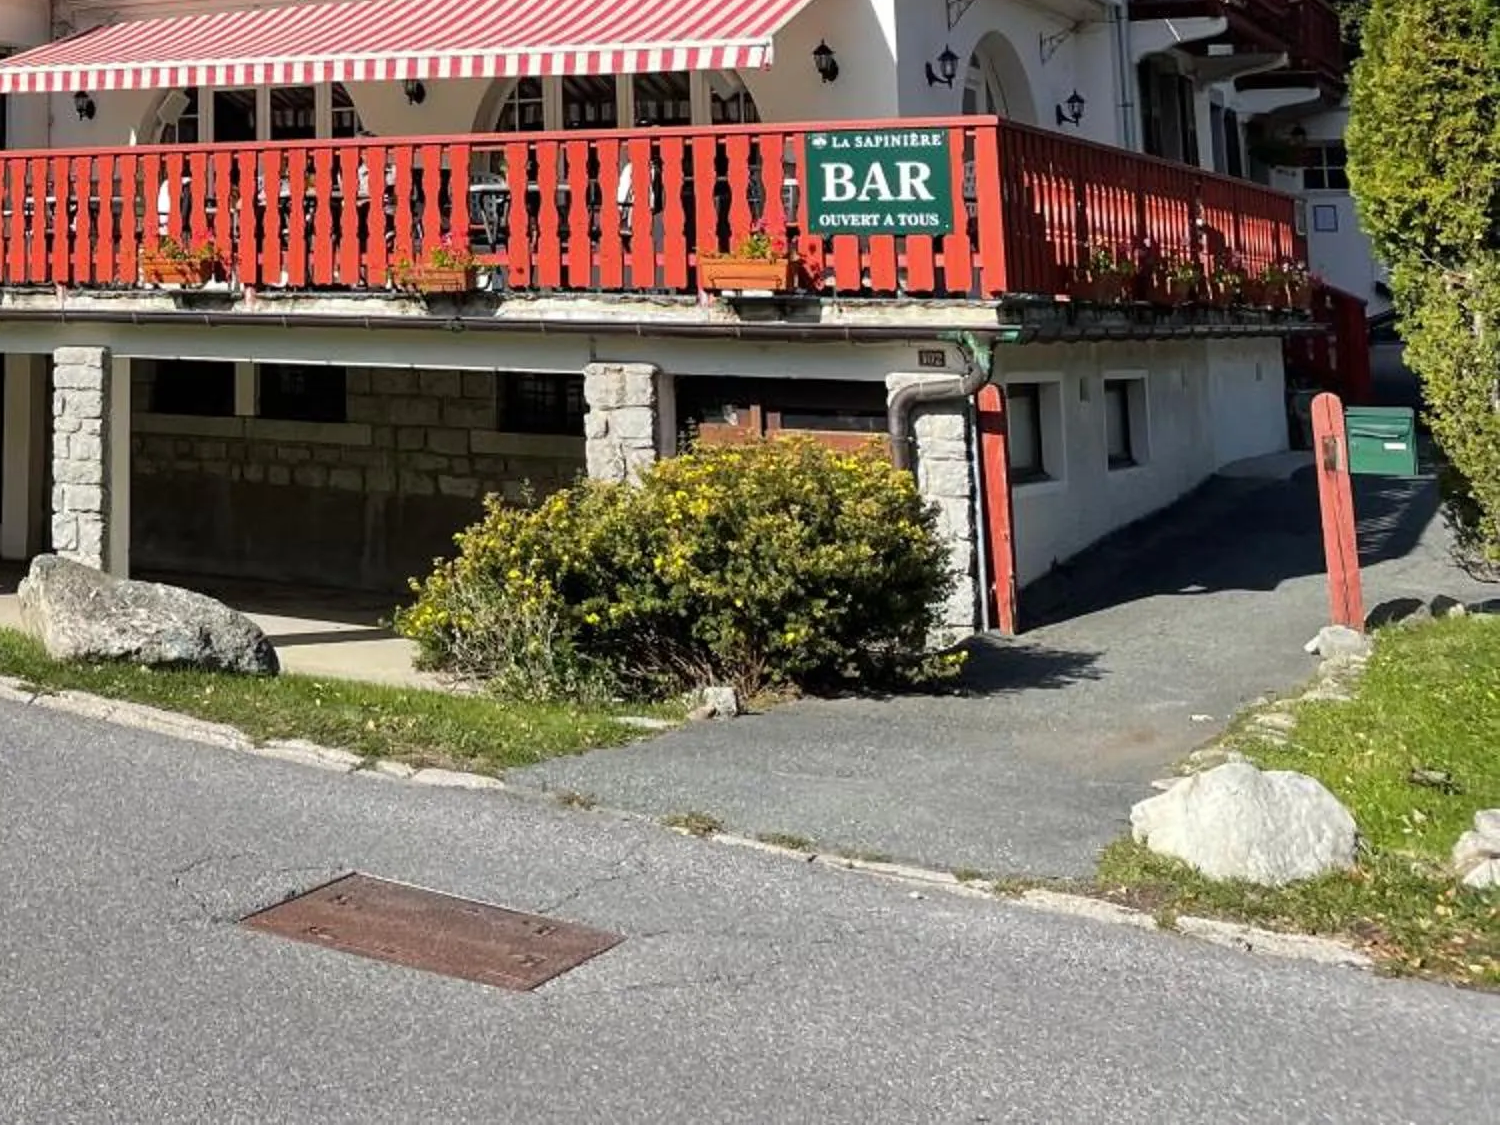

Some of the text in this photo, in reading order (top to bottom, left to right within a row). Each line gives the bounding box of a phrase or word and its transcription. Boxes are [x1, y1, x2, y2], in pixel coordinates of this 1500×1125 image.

[854, 132, 942, 148] SAPINIÈRE
[820, 161, 935, 202] BAR
[819, 212, 940, 227] OUVERT A TOUS
